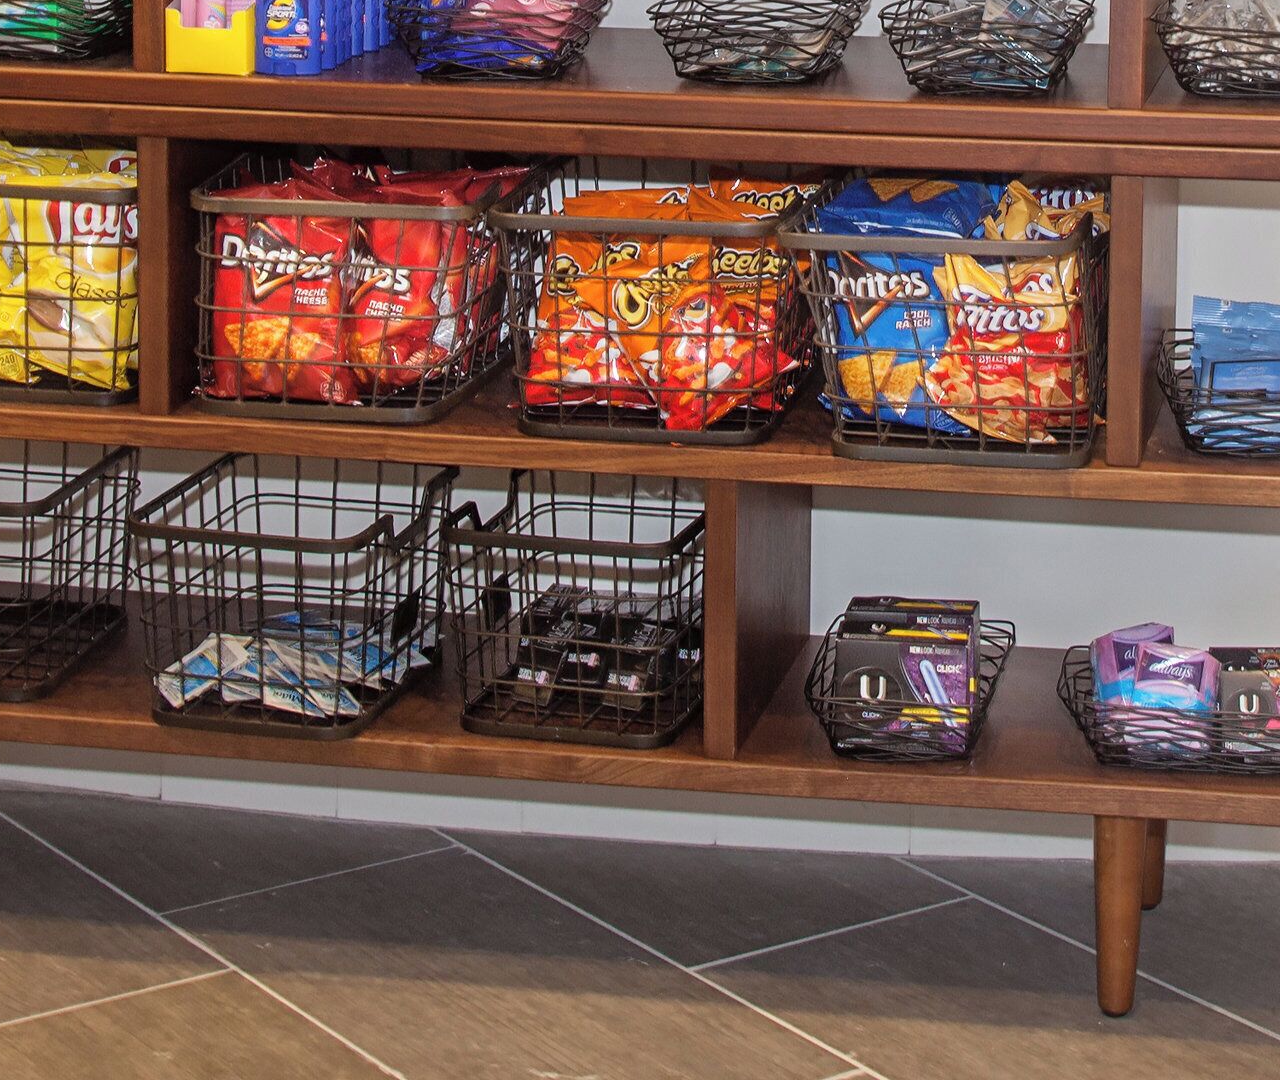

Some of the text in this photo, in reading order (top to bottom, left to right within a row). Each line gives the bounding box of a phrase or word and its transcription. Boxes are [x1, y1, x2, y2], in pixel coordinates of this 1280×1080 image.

[221, 234, 336, 279] Doritos
[294, 287, 328, 297] NACHO
[0, 354, 15, 365] 240
[910, 646, 933, 655] NEW LOOK
[936, 665, 962, 674] CLICK
[1149, 660, 1192, 680] always
[860, 675, 886, 704] U
[1239, 694, 1259, 714] U
